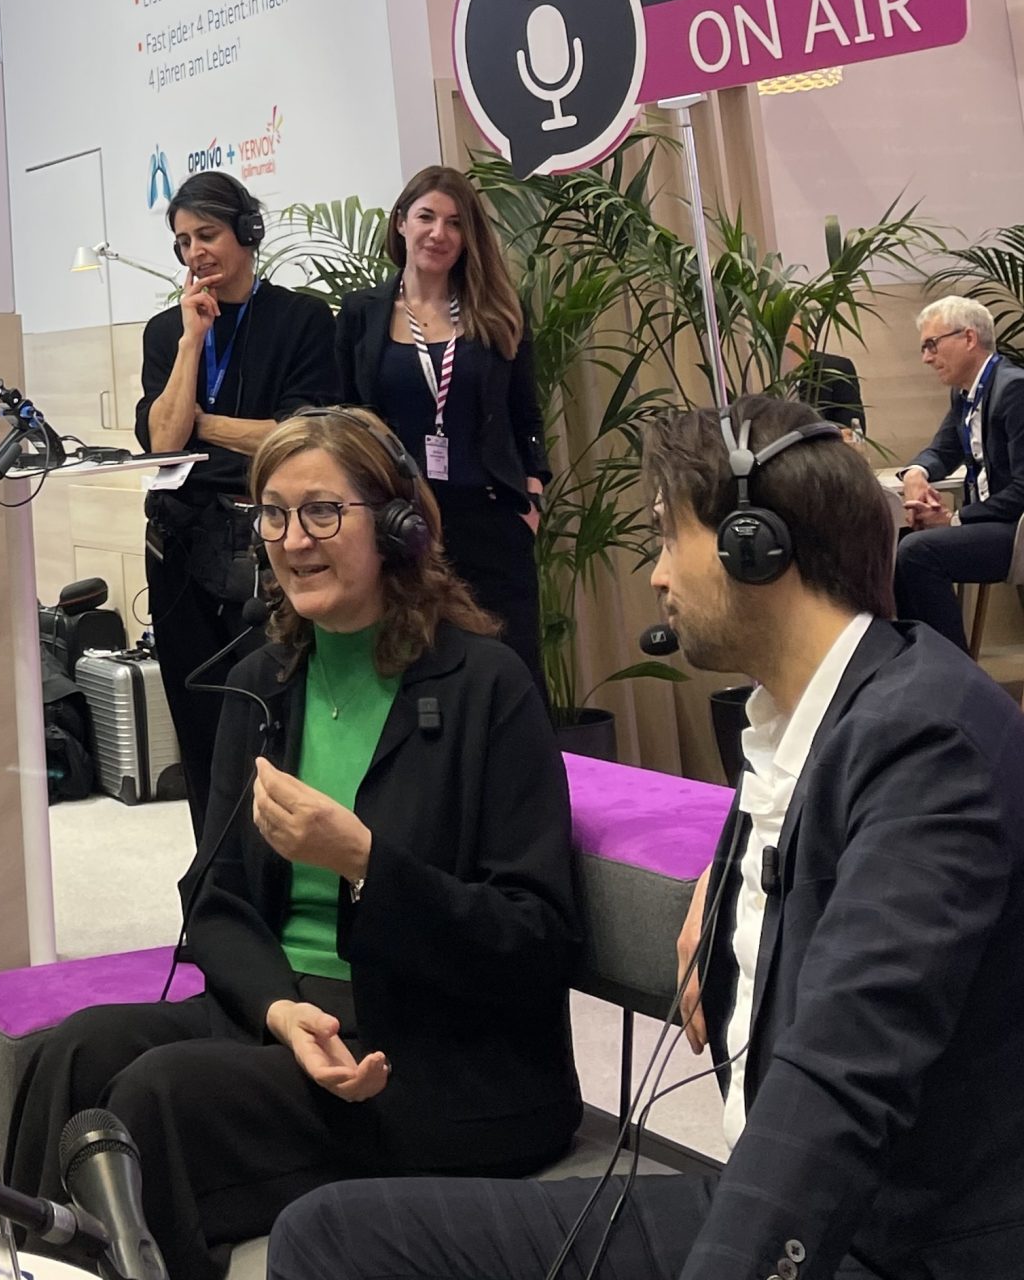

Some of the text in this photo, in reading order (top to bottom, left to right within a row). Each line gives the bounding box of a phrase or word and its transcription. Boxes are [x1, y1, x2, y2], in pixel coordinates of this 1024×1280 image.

[146, 31, 166, 54] Fast
[148, 69, 155, 89] 4
[156, 63, 186, 93] Jahren
[188, 56, 205, 77] am
